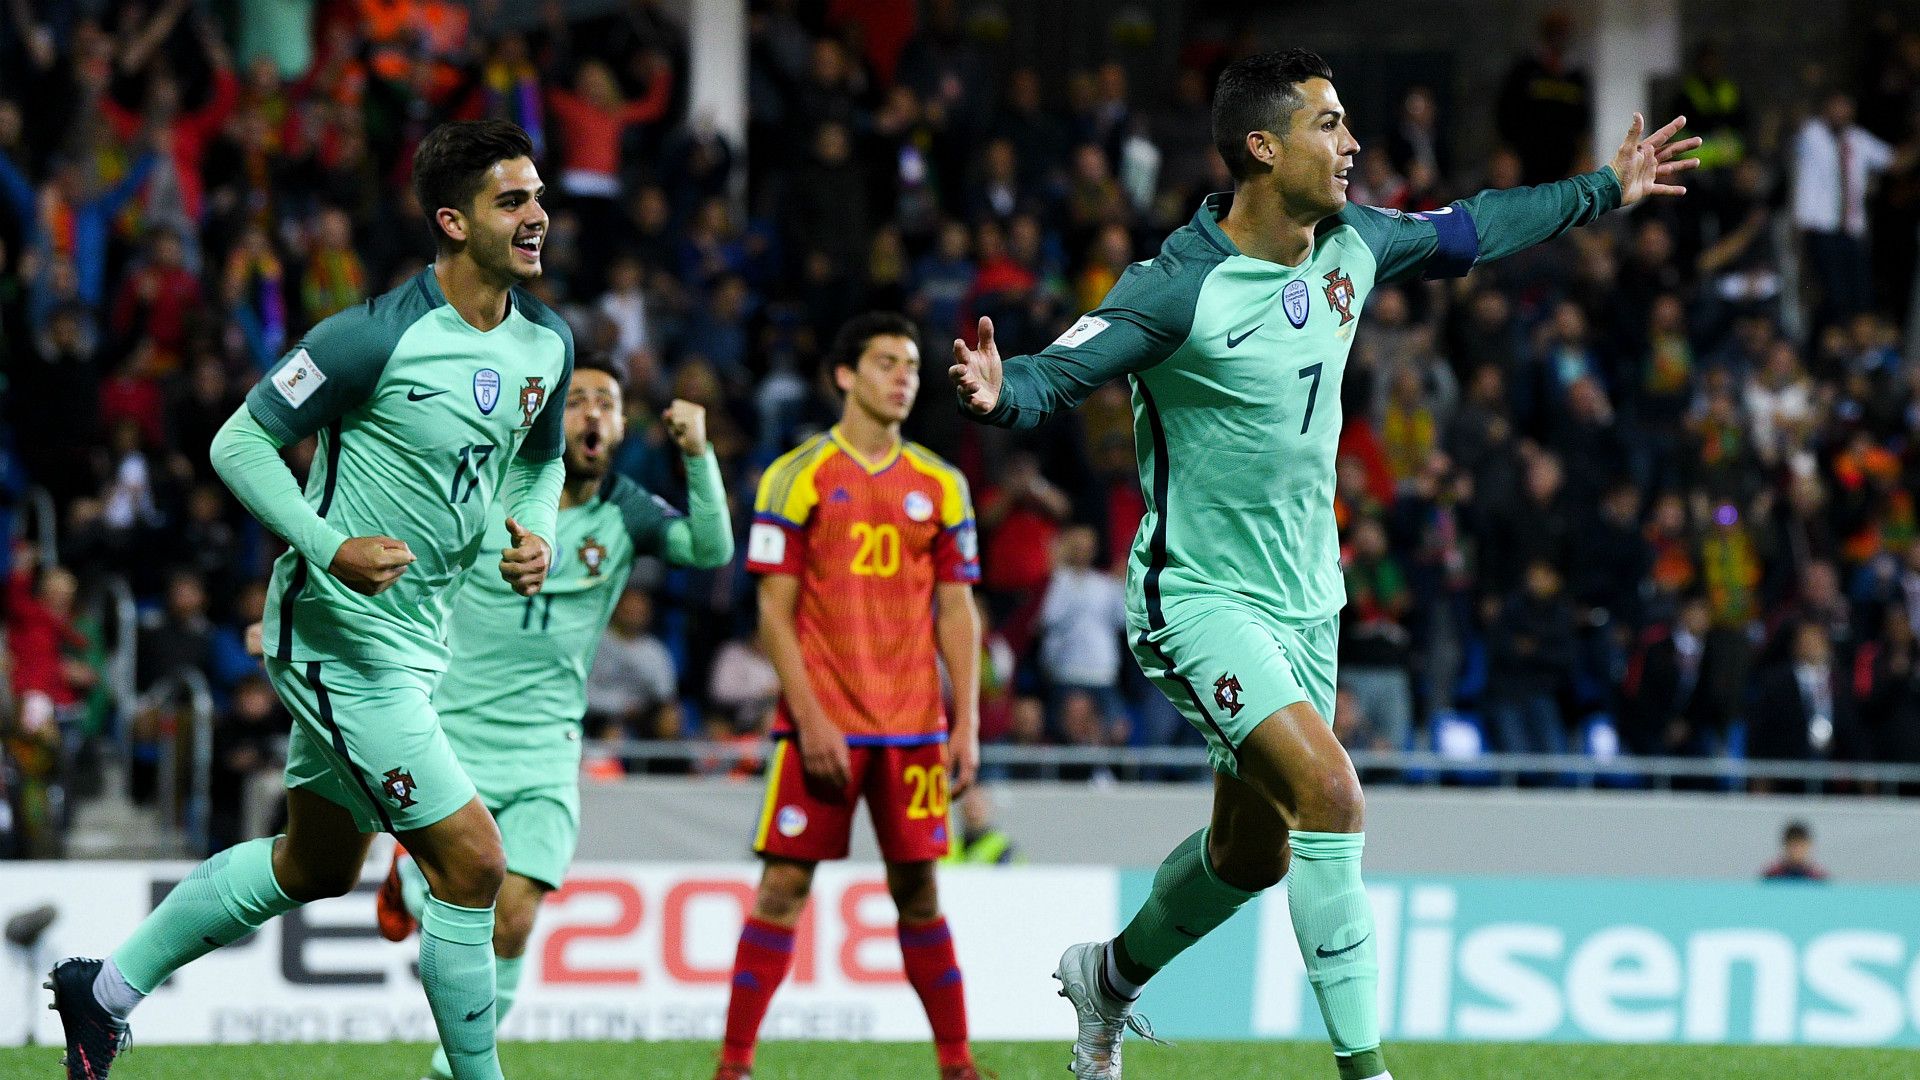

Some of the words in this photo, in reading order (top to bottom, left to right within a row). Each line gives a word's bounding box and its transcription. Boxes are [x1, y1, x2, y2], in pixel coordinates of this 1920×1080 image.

[1299, 361, 1324, 435] 7
[450, 443, 497, 504] 17
[851, 521, 902, 578] 20
[904, 764, 949, 820] 20
[1252, 884, 1920, 1044] Hisens
[658, 1003, 878, 1040] SOCER
